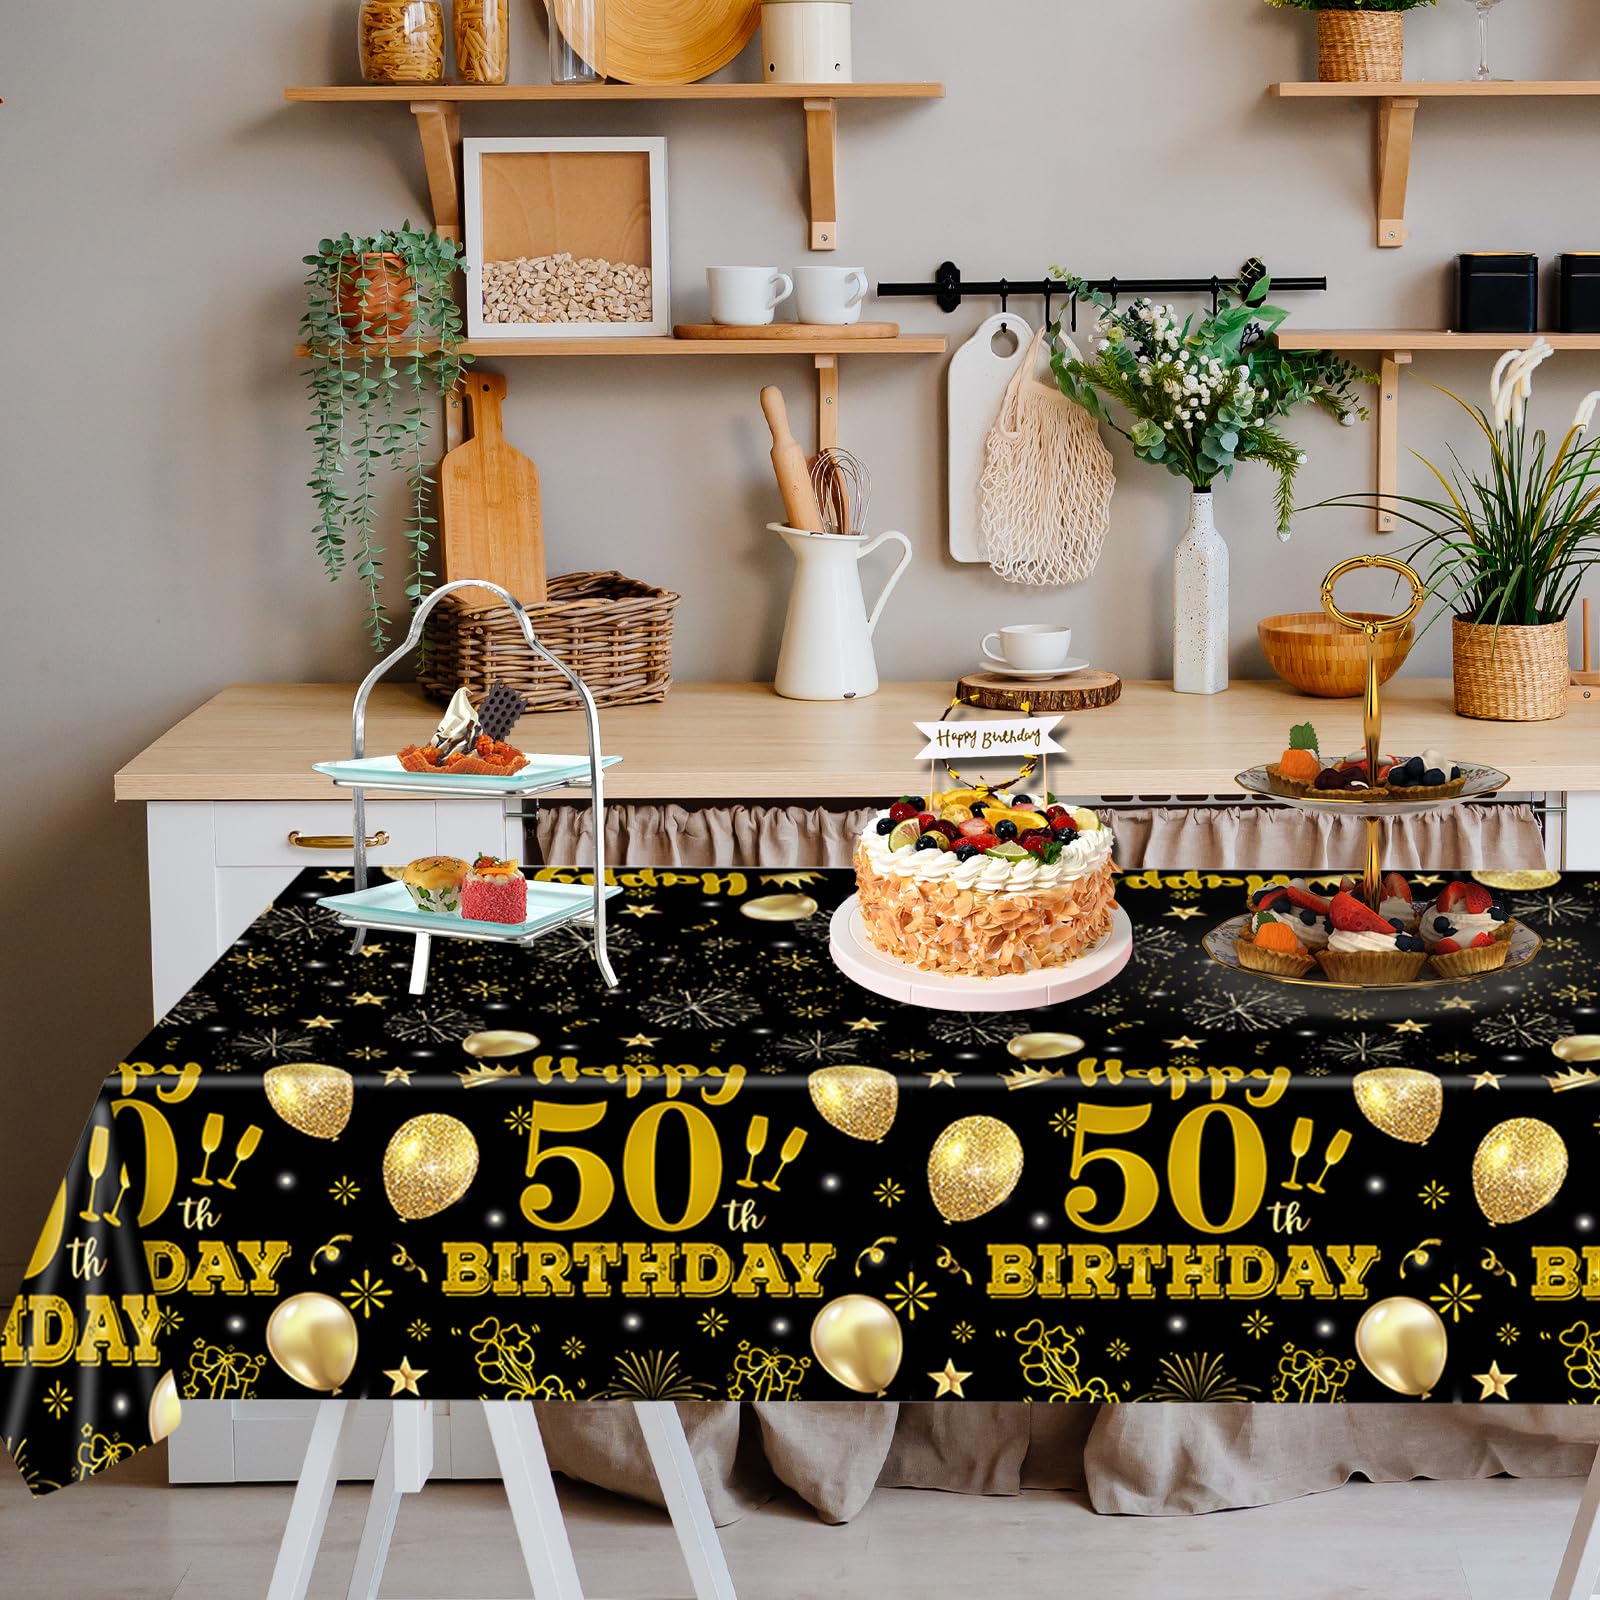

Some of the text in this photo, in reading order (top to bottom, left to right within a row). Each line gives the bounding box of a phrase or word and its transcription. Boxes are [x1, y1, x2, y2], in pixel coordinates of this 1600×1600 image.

[936, 727, 1041, 750] Happy Birthday
[532, 1055, 747, 1106] Happy
[1077, 1057, 1292, 1107] Happy
[143, 1240, 292, 1295] DAY
[441, 1241, 837, 1298] BIRTHDAY
[986, 1243, 1381, 1300] BIRTHDAY
